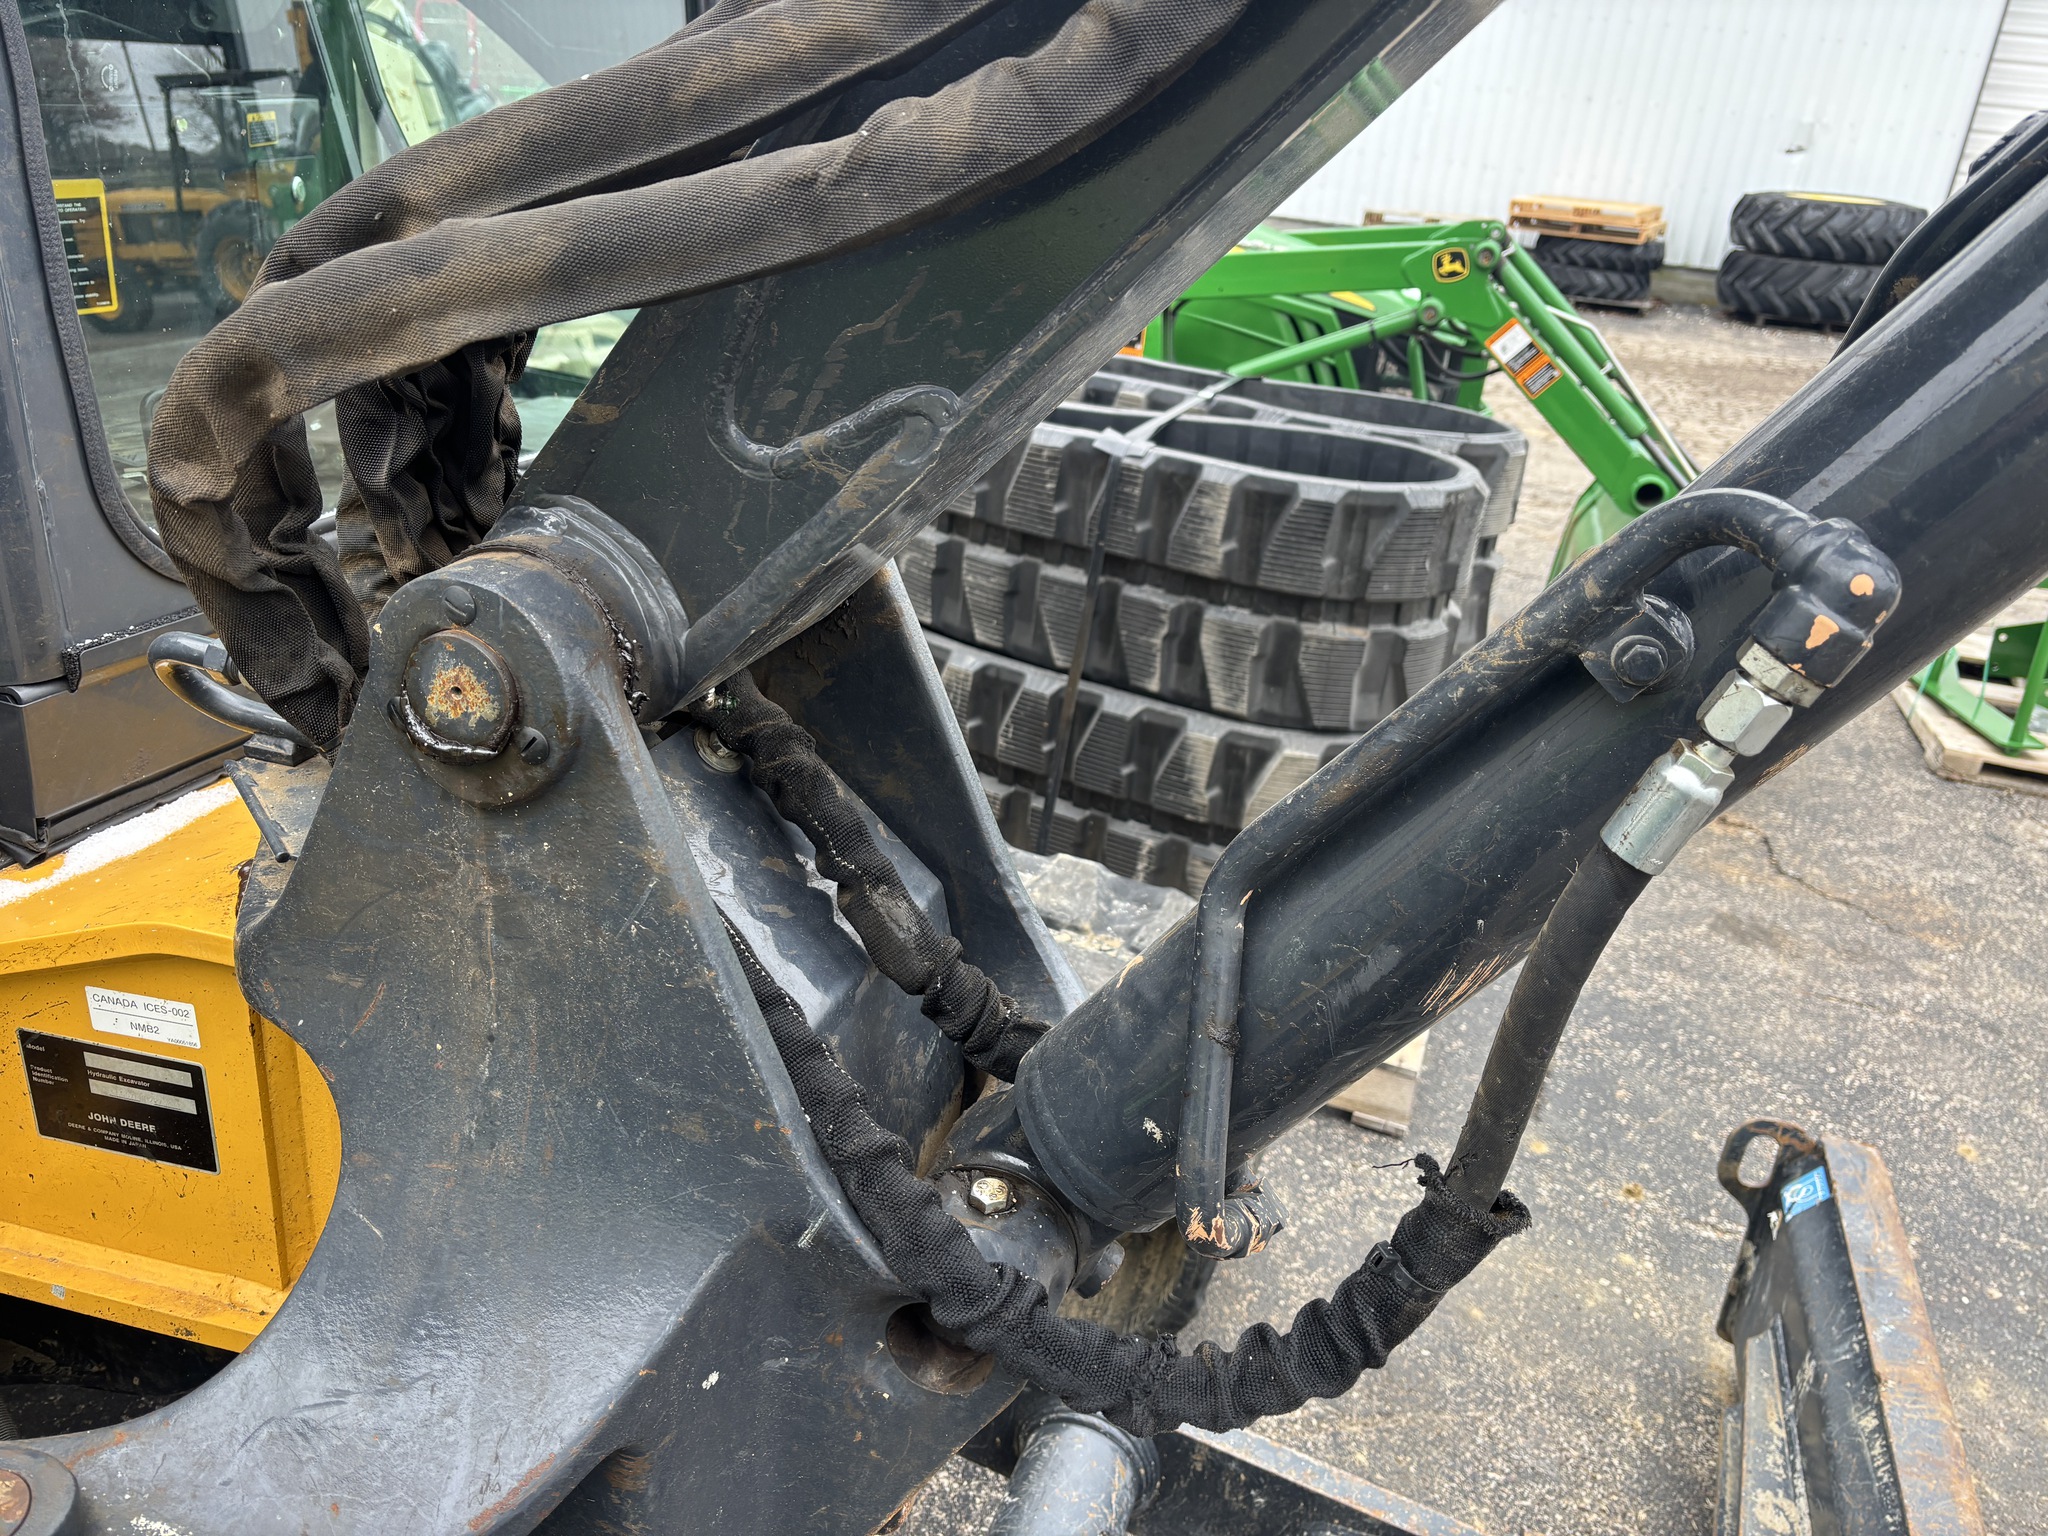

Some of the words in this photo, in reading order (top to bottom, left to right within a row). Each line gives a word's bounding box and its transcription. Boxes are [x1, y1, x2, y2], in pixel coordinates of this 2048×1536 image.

[92, 993, 138, 1009] CANADA
[143, 1002, 190, 1019] ICES-002
[129, 1021, 161, 1035] NMB2
[29, 1064, 53, 1074] Product
[31, 1070, 69, 1083] Identification
[32, 1076, 55, 1086] Number
[86, 1069, 117, 1081] Hydraulic
[118, 1075, 151, 1088] Excavator
[87, 1111, 117, 1125] JOHN
[119, 1118, 157, 1133] DEERE
[67, 1121, 86, 1131] DEERE
[92, 1127, 120, 1138] COMPANY
[104, 1135, 120, 1143] MADE
[128, 1140, 147, 1149] JAPAN
